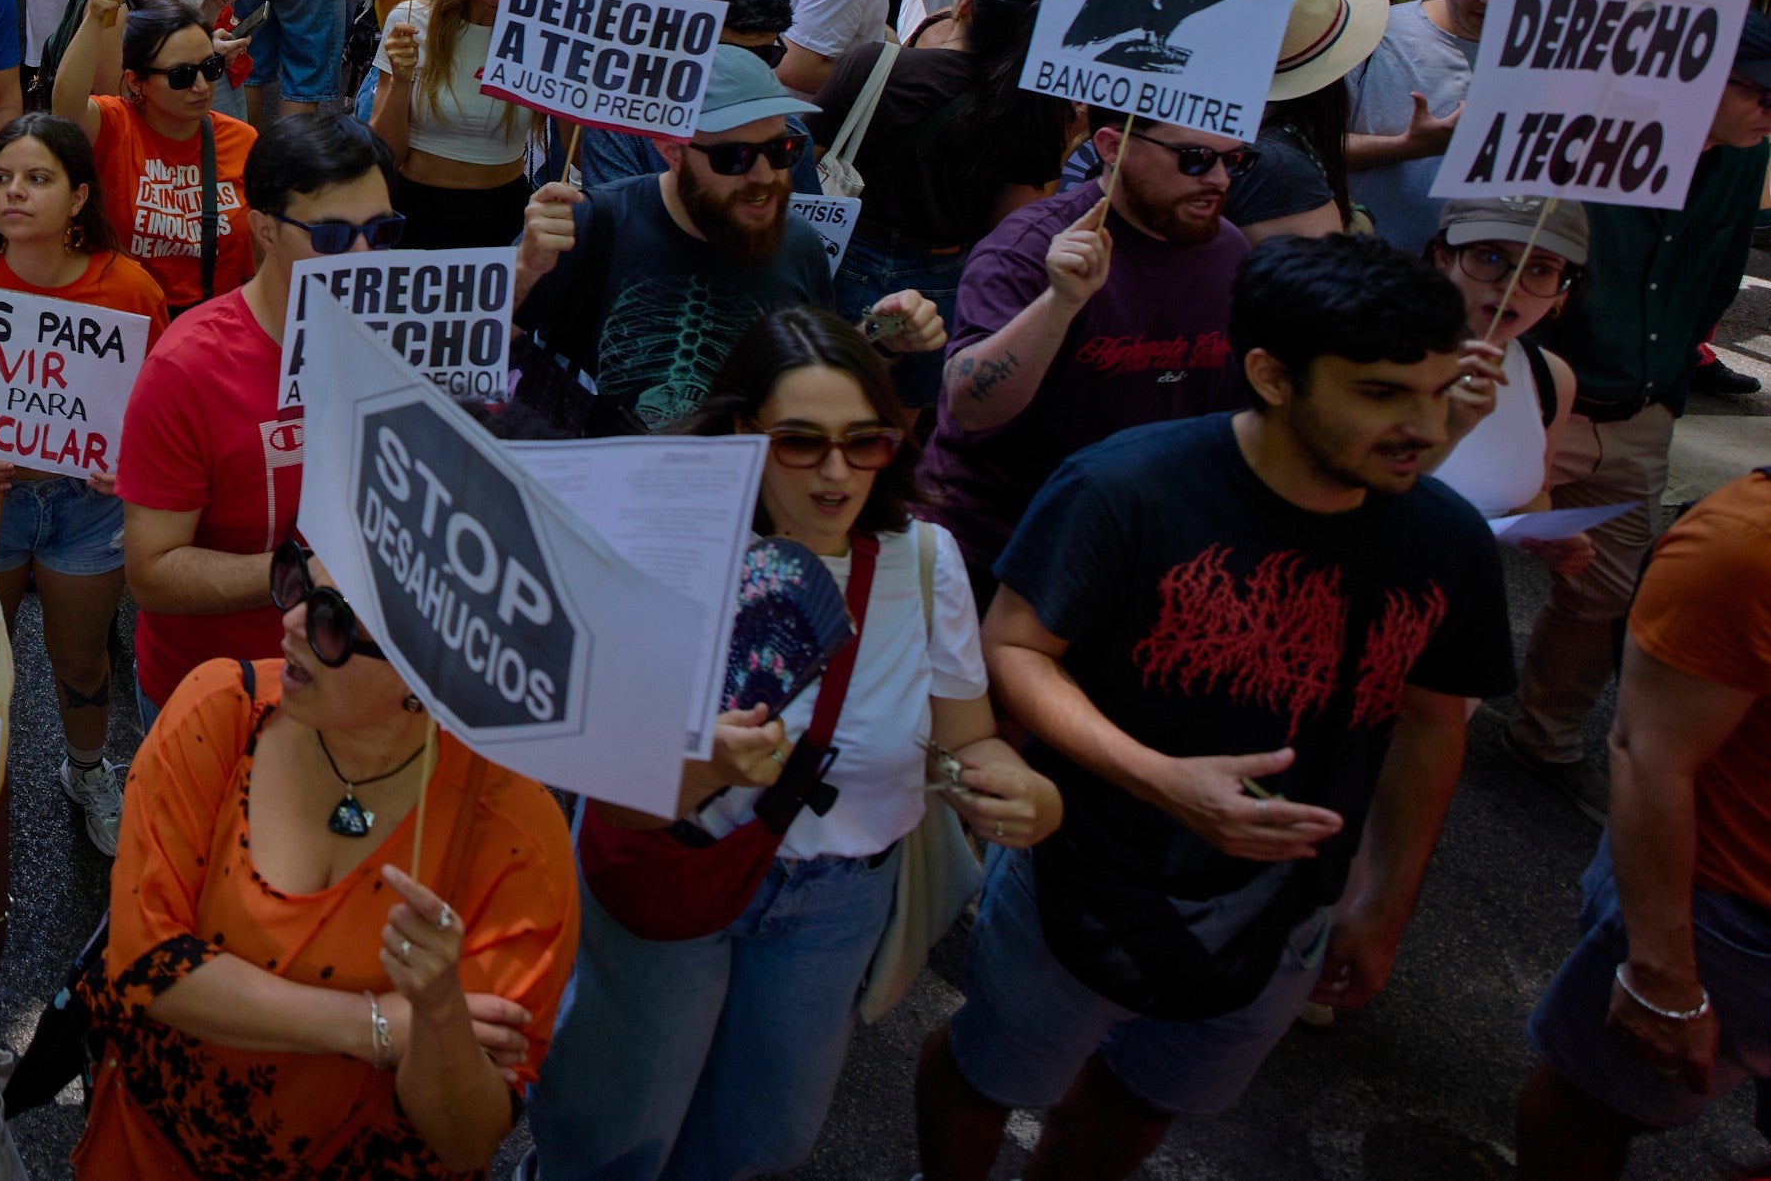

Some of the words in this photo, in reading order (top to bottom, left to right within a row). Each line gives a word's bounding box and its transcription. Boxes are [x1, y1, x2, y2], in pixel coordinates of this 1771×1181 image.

[489, 62, 508, 87] A
[509, 66, 590, 110] JUSTO
[592, 92, 695, 131] PRECIO!
[494, 19, 525, 65] A
[537, 30, 706, 105] TECHO
[1034, 59, 1130, 109] BANCO
[1134, 81, 1246, 138] BUITRE.
[1464, 111, 1508, 184] A
[1505, 111, 1669, 195] TECHO.
[37, 311, 126, 363] PARA
[6, 387, 88, 422] PARA
[375, 425, 553, 626] STOP
[362, 486, 556, 722] DESAHUCIOS
